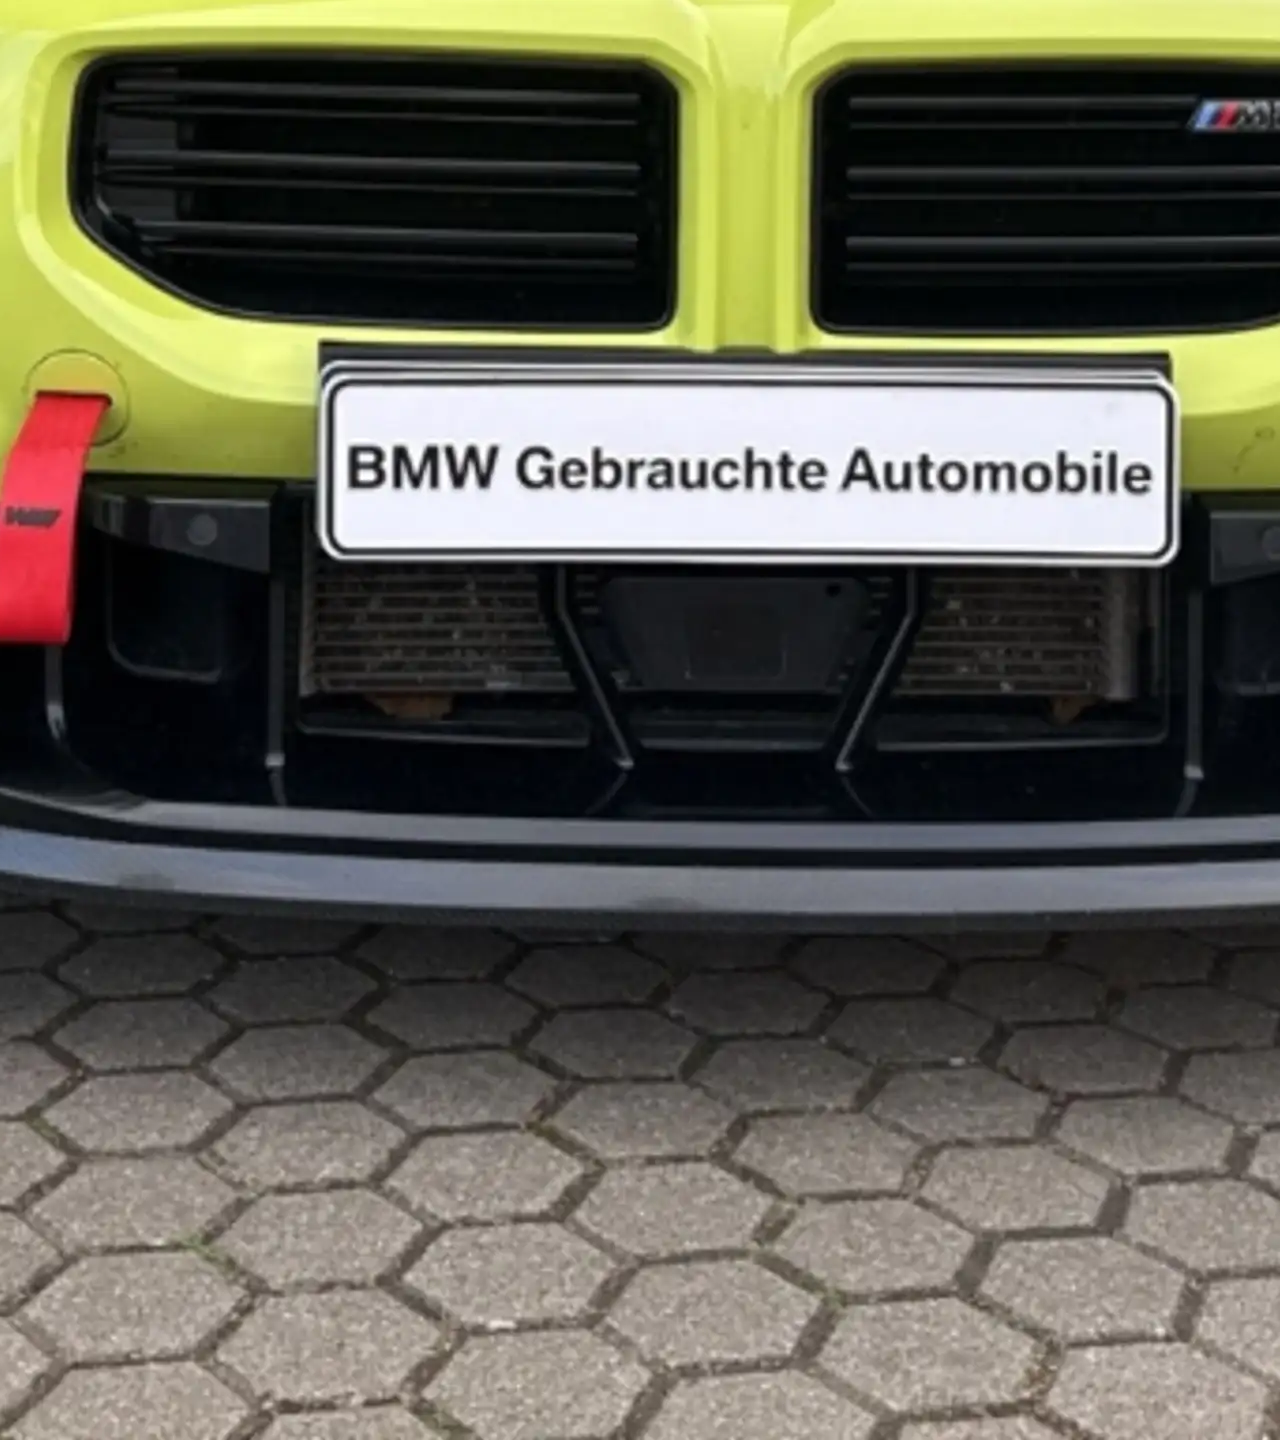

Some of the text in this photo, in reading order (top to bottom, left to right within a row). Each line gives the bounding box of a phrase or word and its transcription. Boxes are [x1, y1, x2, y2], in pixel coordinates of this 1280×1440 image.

[347, 444, 1153, 495] BMW Gebrauchte Automobile
